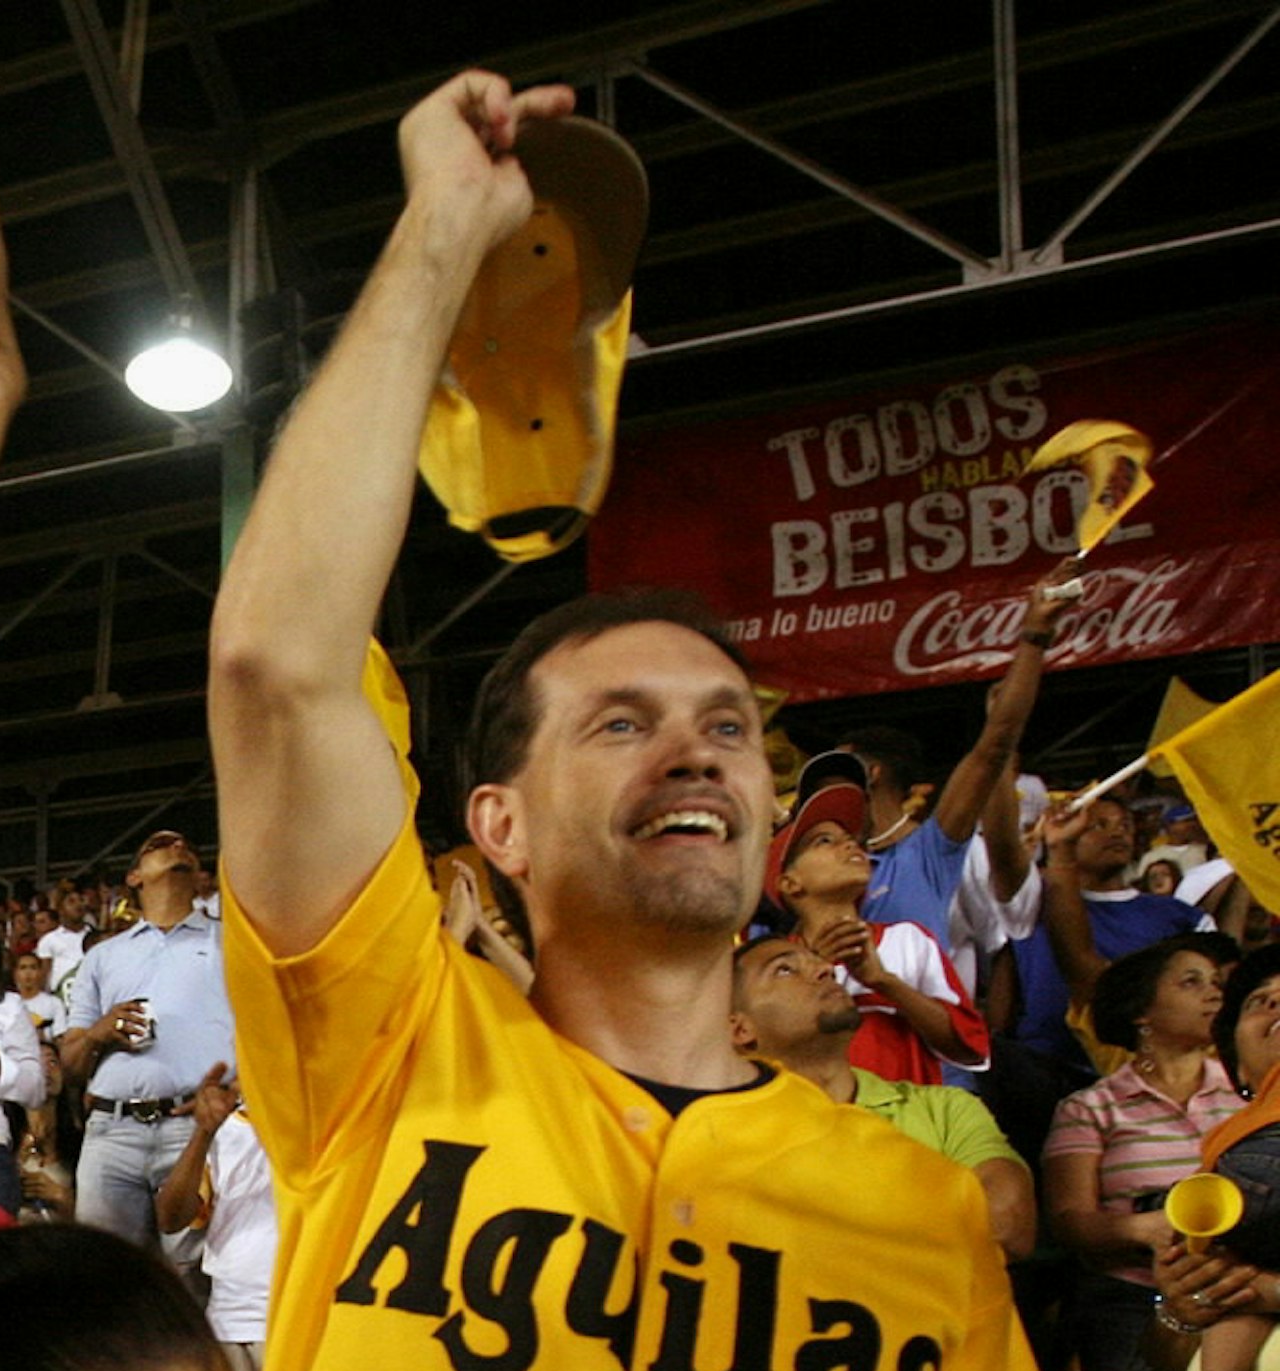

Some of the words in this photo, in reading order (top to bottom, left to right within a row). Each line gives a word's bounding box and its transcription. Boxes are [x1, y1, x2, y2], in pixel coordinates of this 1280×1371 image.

[767, 364, 1048, 502] TODOS
[771, 607, 797, 638] lo
[806, 598, 896, 633] bueno
[893, 561, 1190, 675] CocaCola
